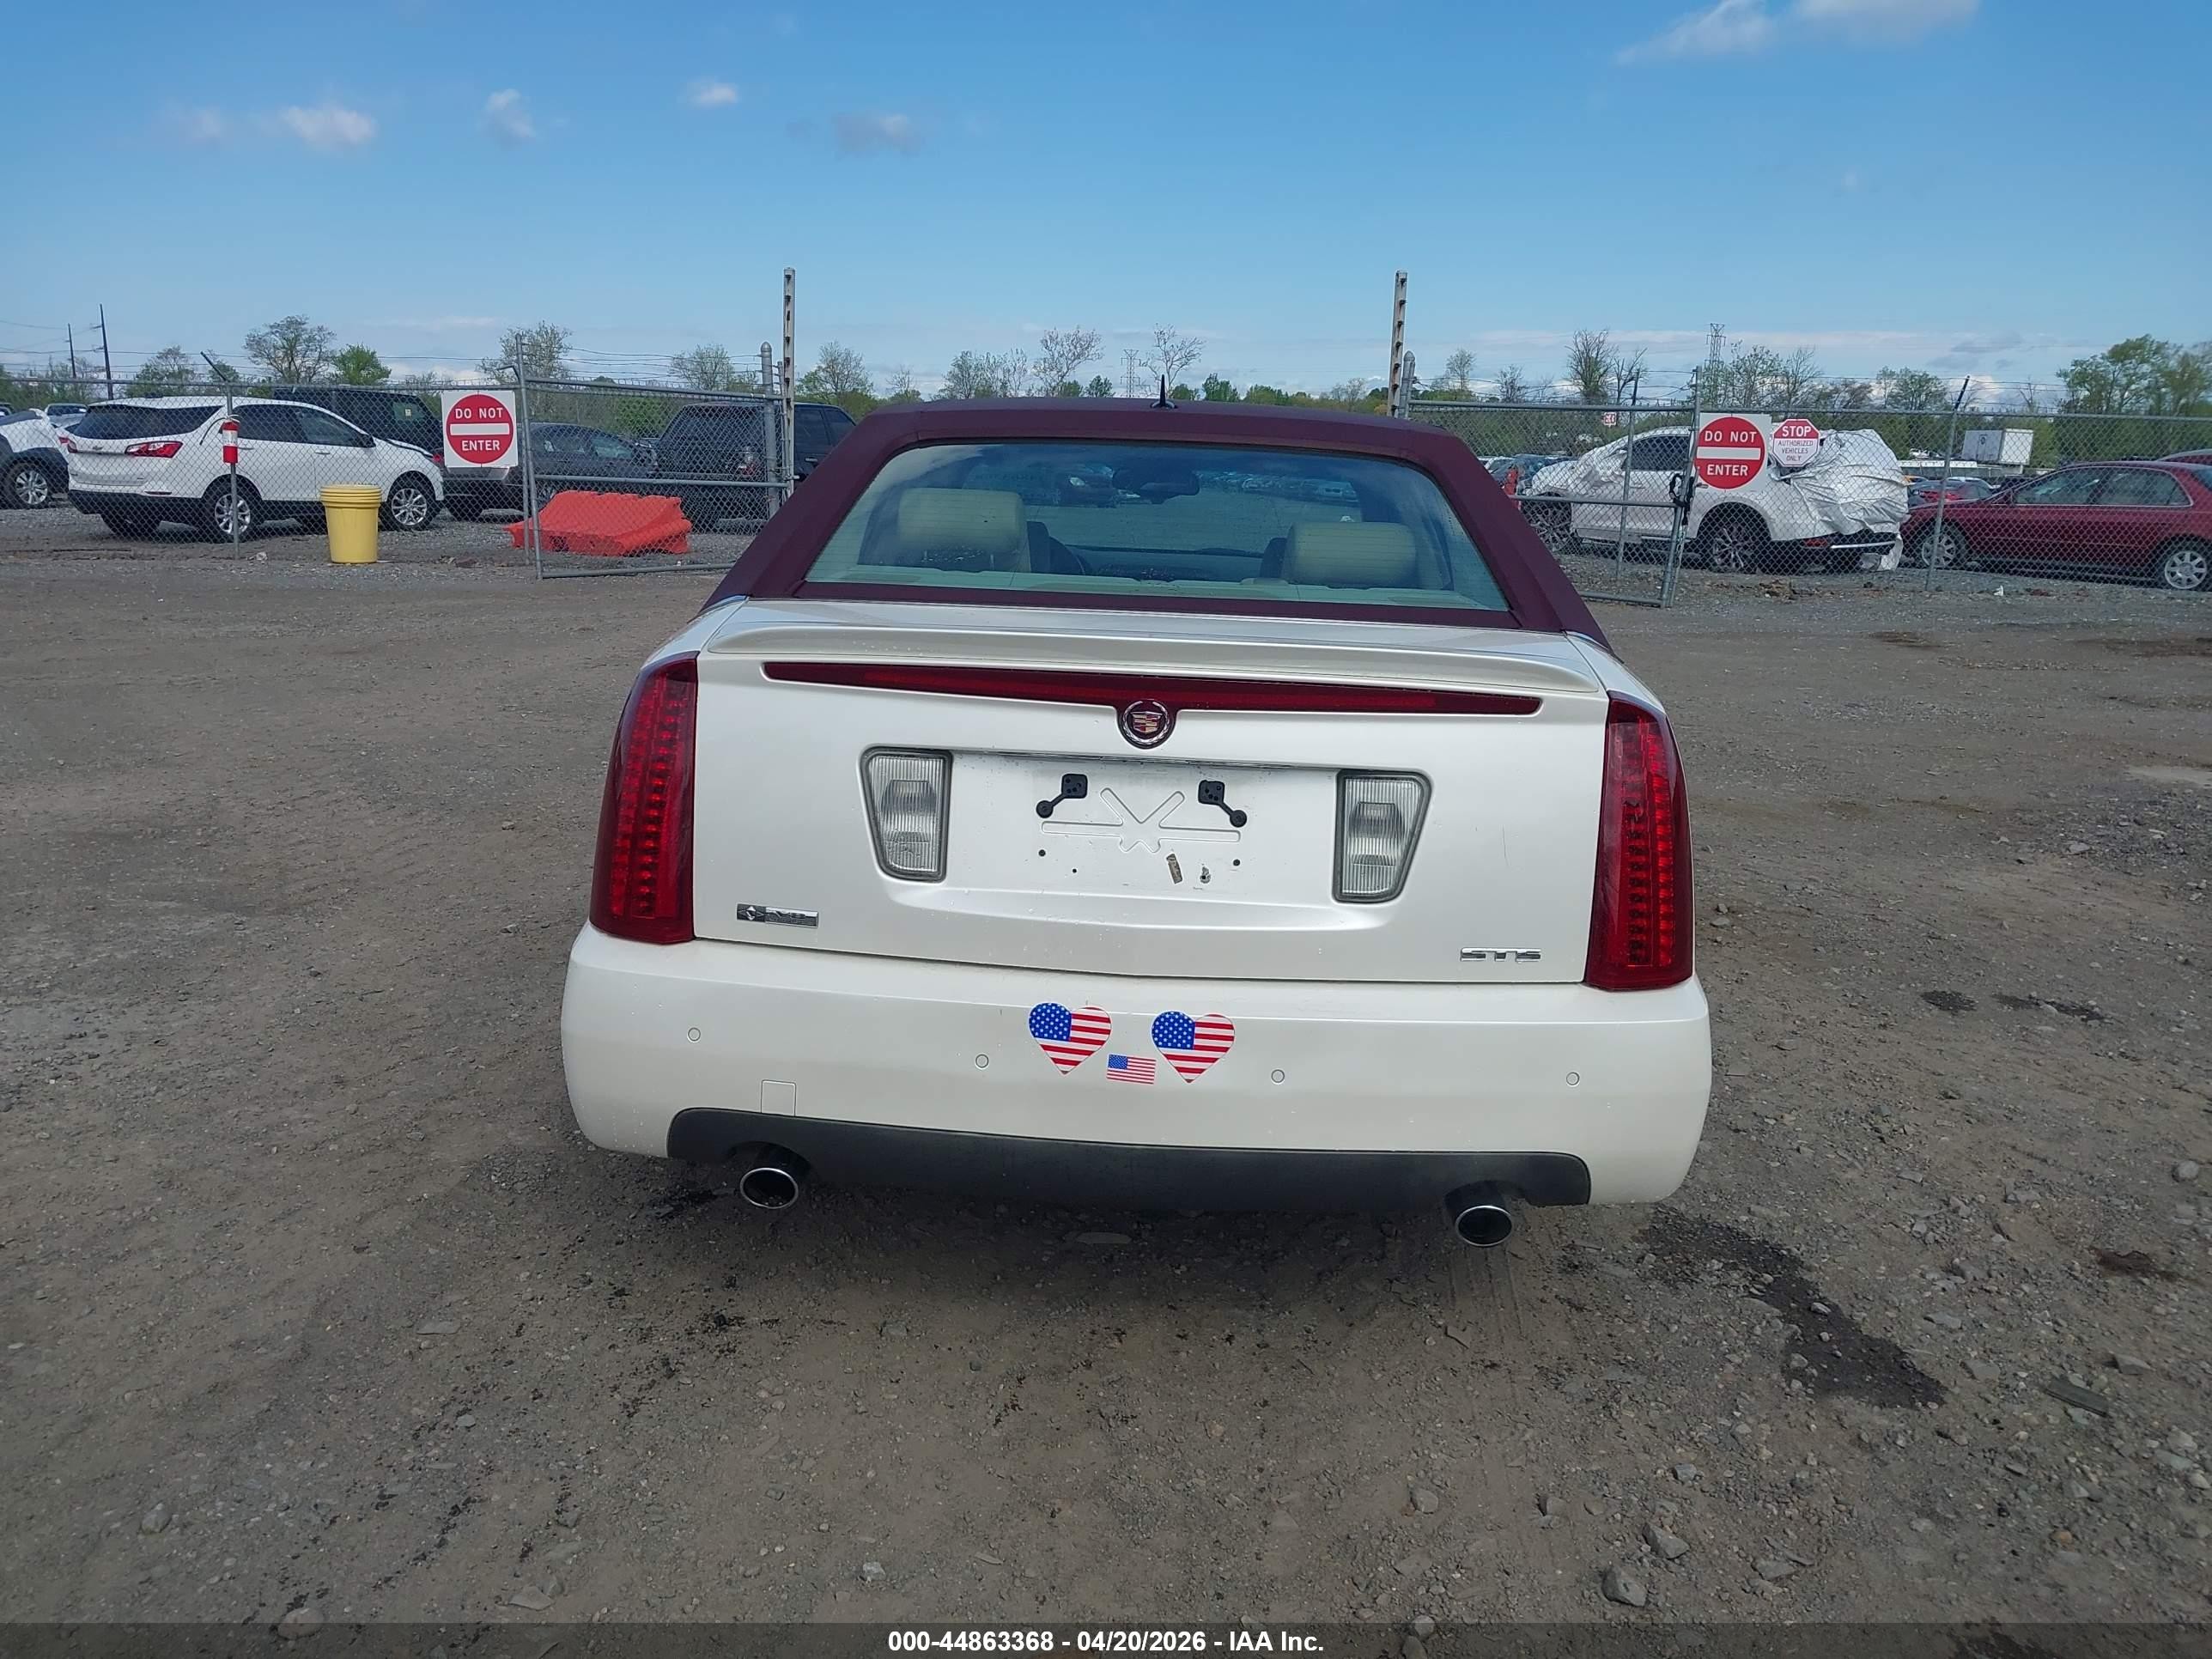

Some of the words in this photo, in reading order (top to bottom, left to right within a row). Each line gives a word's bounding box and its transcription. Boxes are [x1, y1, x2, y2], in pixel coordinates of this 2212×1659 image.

[455, 408, 472, 419] DO
[479, 407, 503, 419] NOT
[1705, 430, 1723, 442] DO
[1730, 431, 1757, 443] NOT
[1782, 425, 1812, 437] STOP
[461, 440, 501, 452] ENTER
[1707, 464, 1749, 477] ENTER
[1460, 947, 1542, 963] STS
